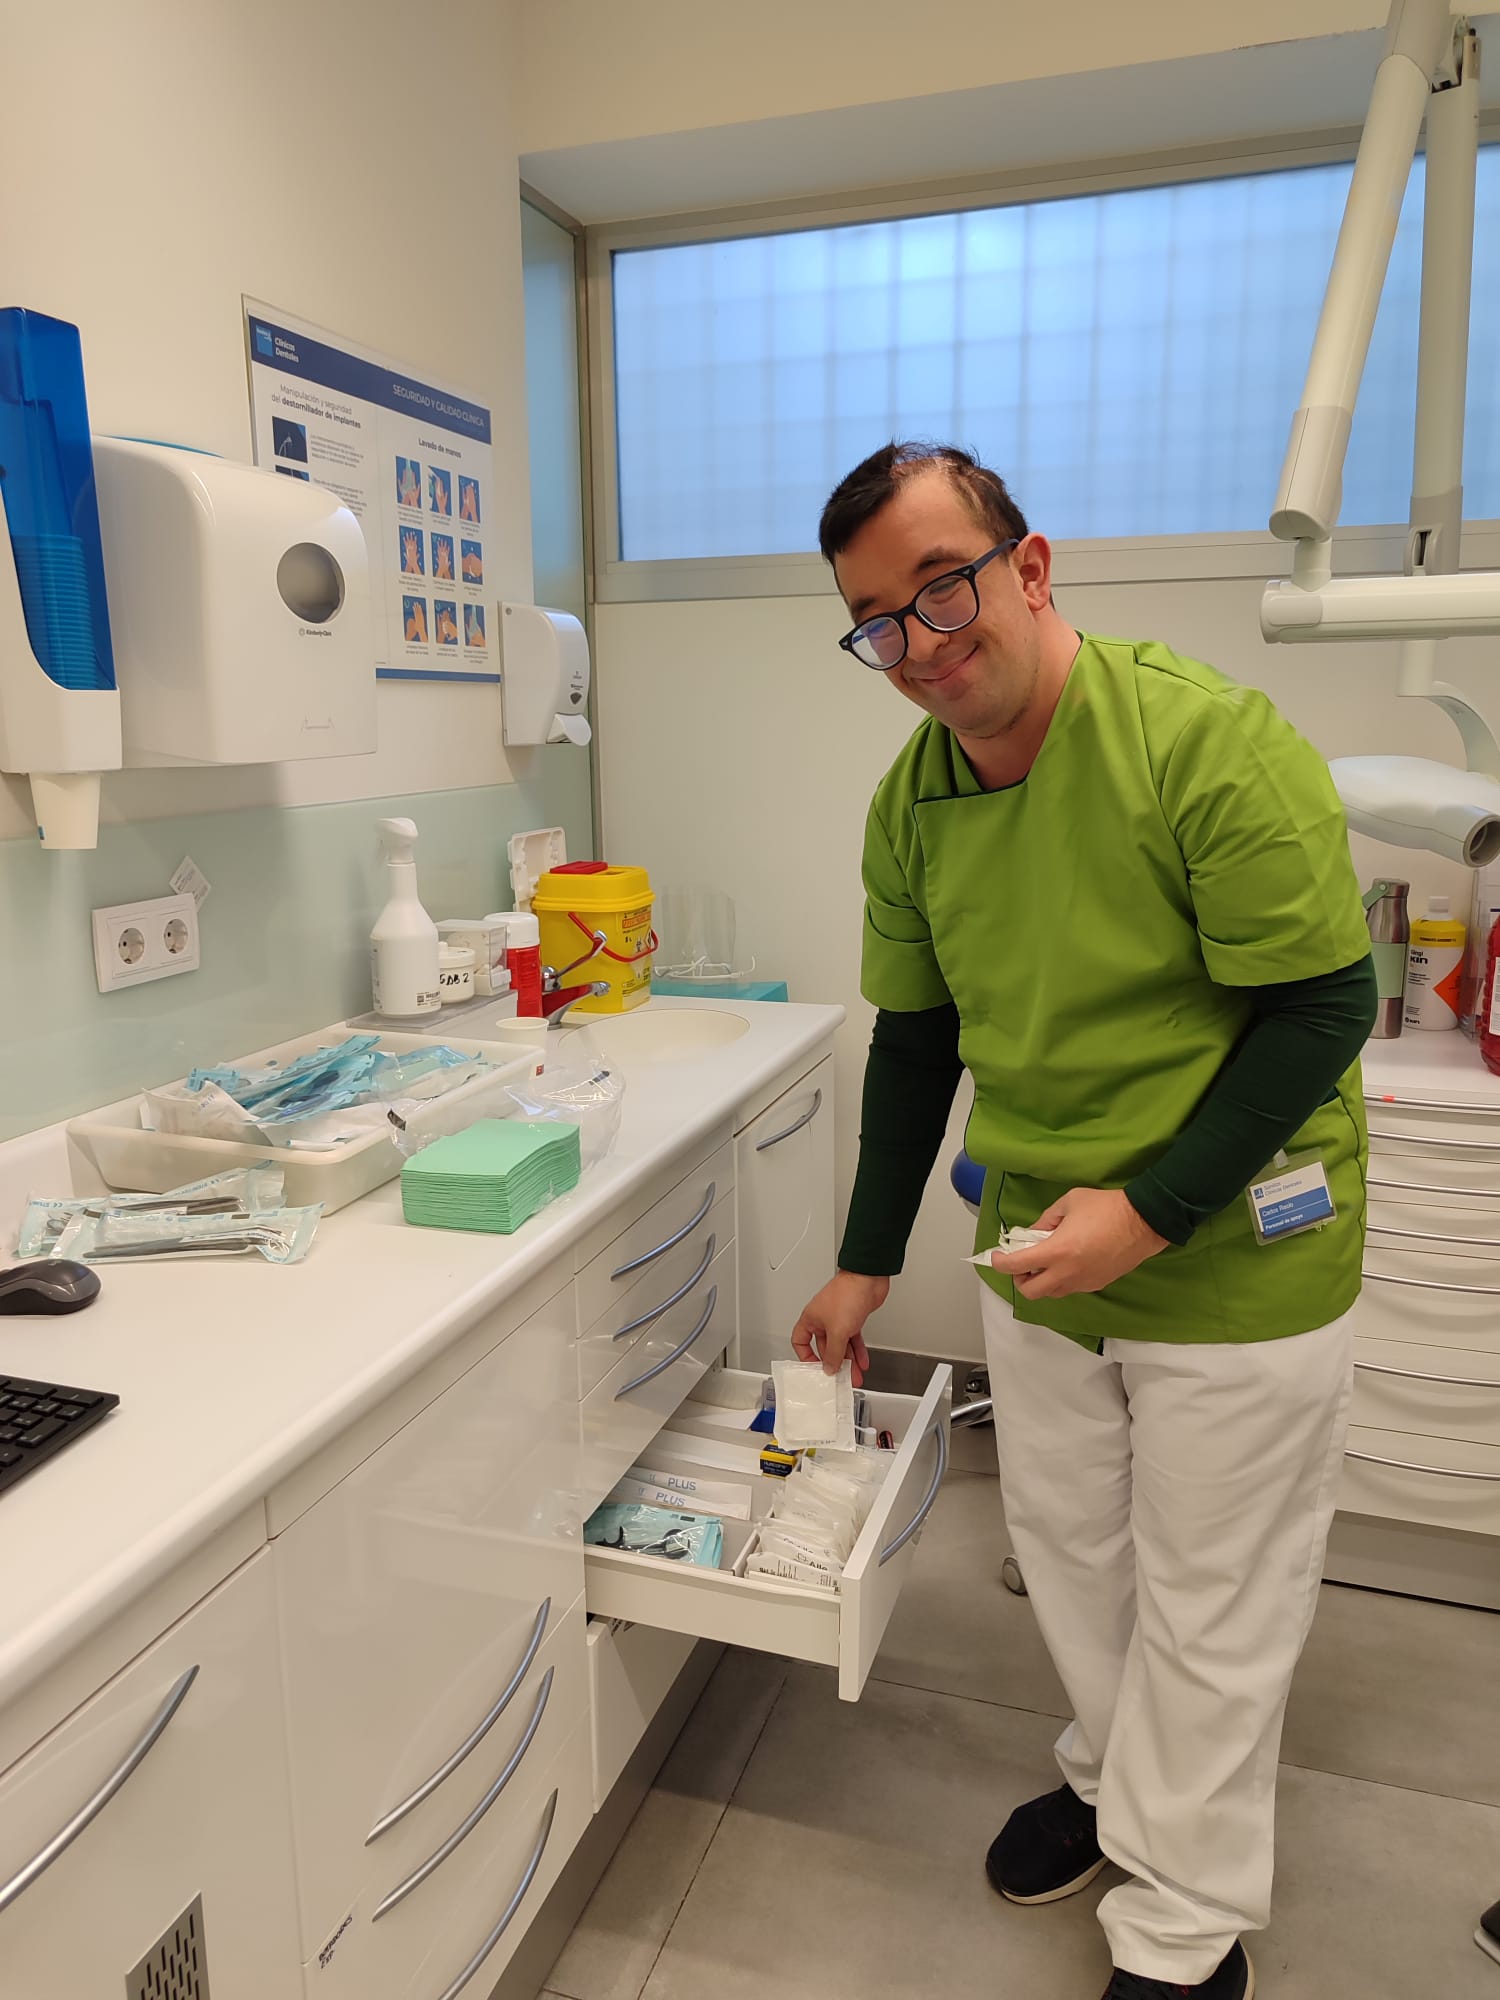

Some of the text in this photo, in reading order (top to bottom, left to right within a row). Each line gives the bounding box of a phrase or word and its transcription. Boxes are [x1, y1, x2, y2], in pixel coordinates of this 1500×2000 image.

[392, 384, 430, 407] SEGURIDAD
[435, 401, 462, 419] CALIDAD
[271, 394, 361, 429] del destornillador de implantes
[418, 438, 437, 451] Lavado
[437, 443, 445, 453] de
[463, 972, 470, 983] 2
[667, 1476, 697, 1491] PLUS
[655, 1492, 686, 1507] PLUS
